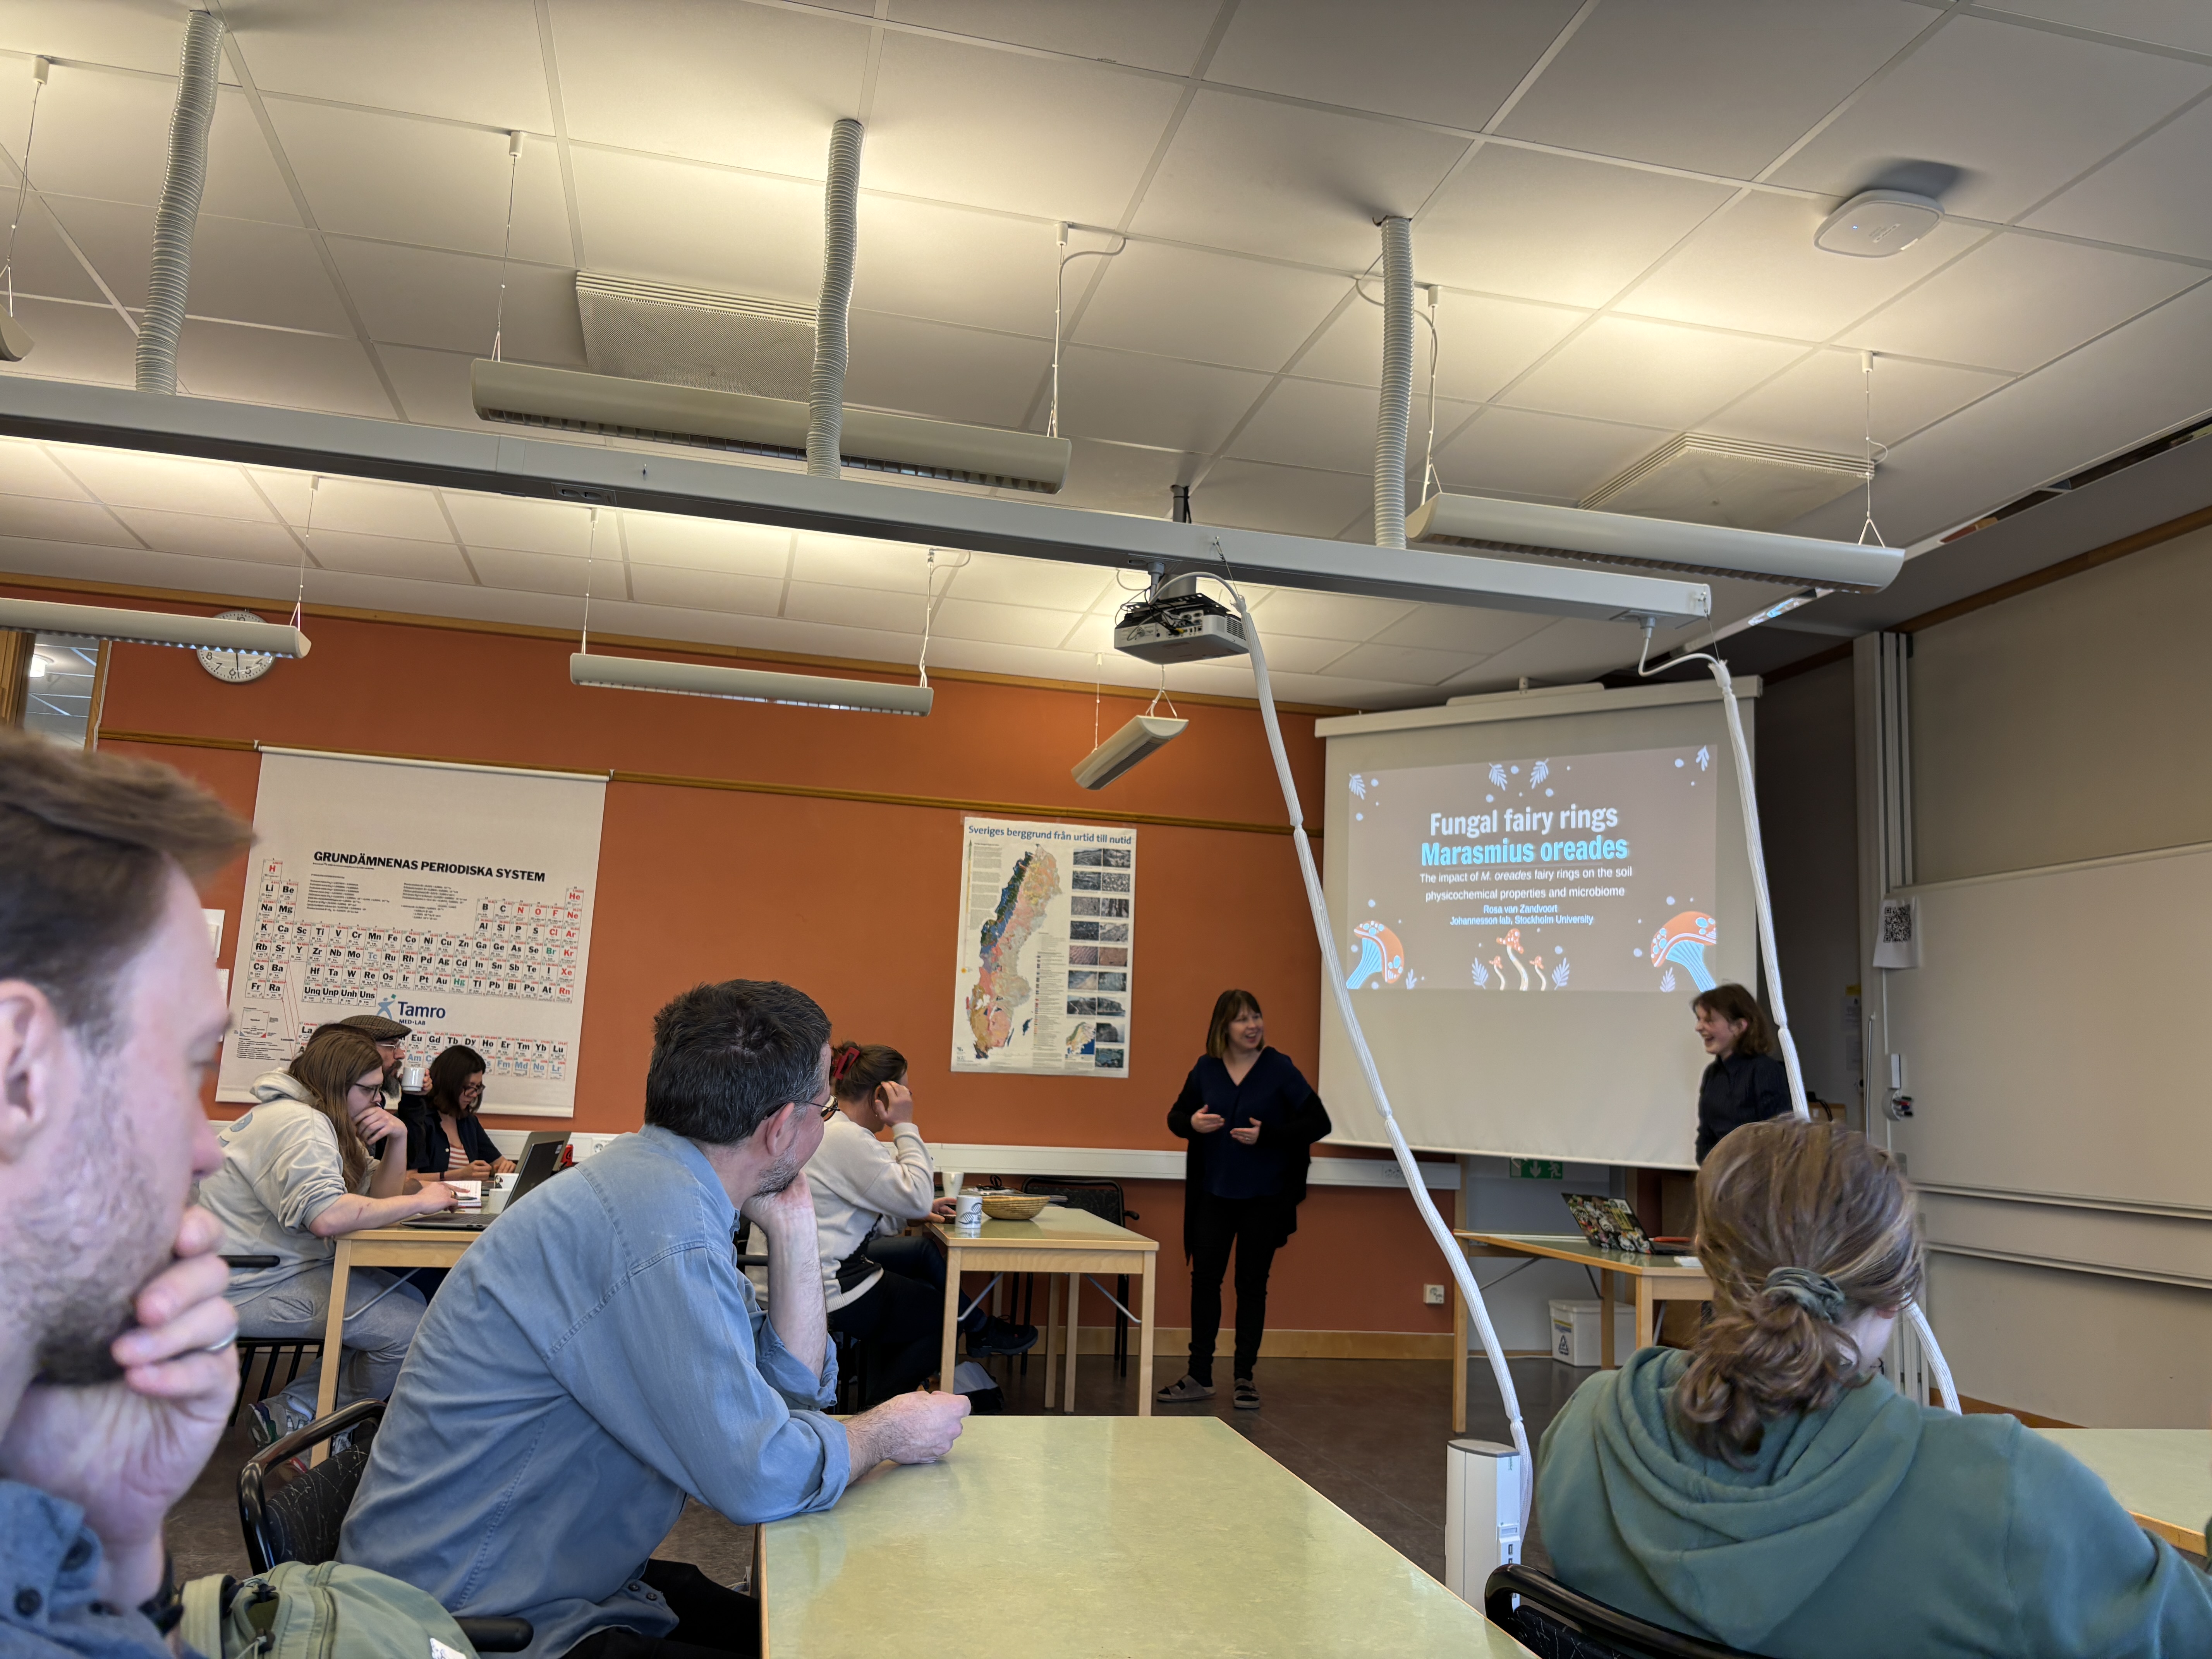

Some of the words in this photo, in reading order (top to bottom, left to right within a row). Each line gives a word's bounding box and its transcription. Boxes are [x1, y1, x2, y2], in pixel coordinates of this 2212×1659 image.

[206, 652, 213, 660] 8
[215, 662, 223, 670] 7
[245, 666, 251, 675] 5
[1431, 809, 1497, 838] Fungal
[1504, 806, 1553, 835] fairy
[1560, 804, 1618, 832] rings
[969, 826, 1004, 837] Sveriges
[1007, 828, 1051, 840] berggrund
[1054, 831, 1071, 840] från
[1074, 833, 1094, 842] urtid
[1110, 836, 1131, 845] nutid
[1422, 838, 1534, 866] Marasmius
[1540, 835, 1628, 862] oreades
[314, 851, 418, 870] GRUNDÄMNENAS
[421, 861, 493, 877] PERIODISKA
[496, 868, 545, 882] SYSTEM
[1420, 873, 1436, 883] The
[1439, 872, 1467, 884] impact
[1470, 871, 1479, 881] of
[1481, 871, 1491, 881] M.
[1494, 869, 1531, 881] oreades
[1535, 869, 1554, 881] fairy
[1557, 868, 1580, 881] rings
[1582, 869, 1594, 878] on
[1597, 867, 1613, 878] the
[1616, 866, 1632, 877] soil
[1426, 888, 1497, 902] physicochemical
[1500, 888, 1546, 900] properties
[1549, 887, 1566, 898] and
[1569, 886, 1625, 897] microbiome
[1484, 905, 1502, 914] Rosa
[1520, 904, 1558, 913] Zandvoort
[1450, 916, 1497, 926] Johannesson
[1499, 915, 1512, 925] lab,
[1515, 915, 1554, 924] Stockholm
[1556, 914, 1593, 925] University
[305, 987, 320, 996] Unq
[323, 988, 338, 997] Unp
[398, 1001, 445, 1018] Tamro
[497, 1060, 510, 1068] Fm
